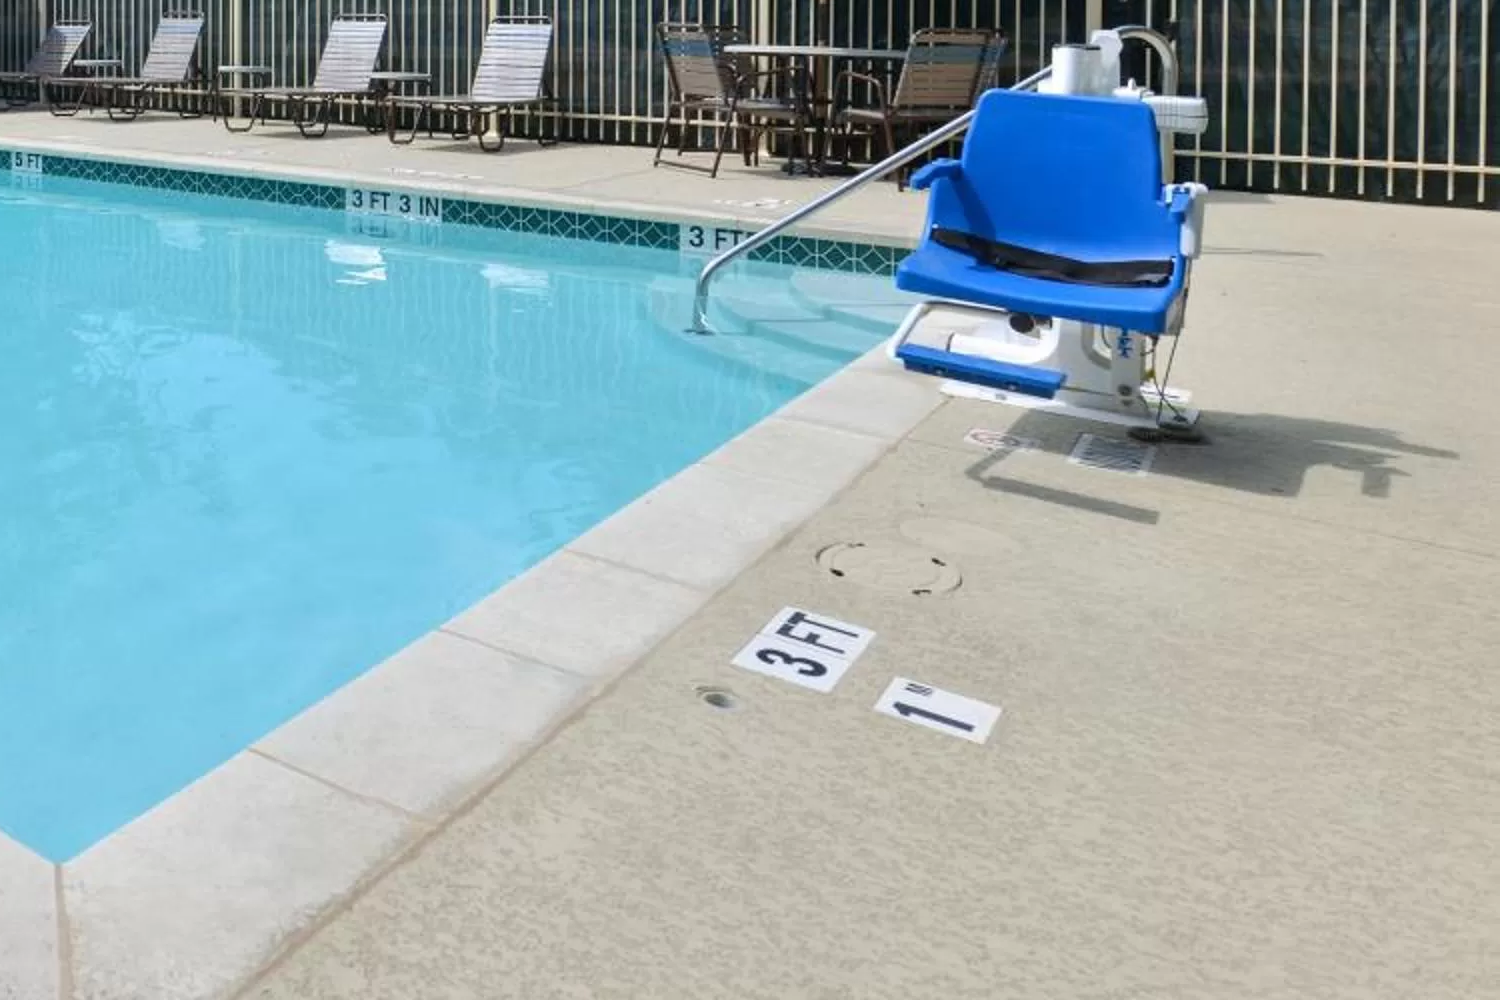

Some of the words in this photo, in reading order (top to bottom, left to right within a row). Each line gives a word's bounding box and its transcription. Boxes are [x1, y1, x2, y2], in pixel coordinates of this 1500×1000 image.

[15, 151, 23, 167] 5
[27, 153, 41, 169] FT
[352, 189, 364, 208] 3
[369, 191, 391, 212] FT
[399, 194, 411, 213] 3
[419, 196, 439, 217] IN
[689, 225, 705, 248] 3
[715, 227, 743, 251] FT
[775, 611, 860, 655] FT
[755, 647, 828, 678] 3
